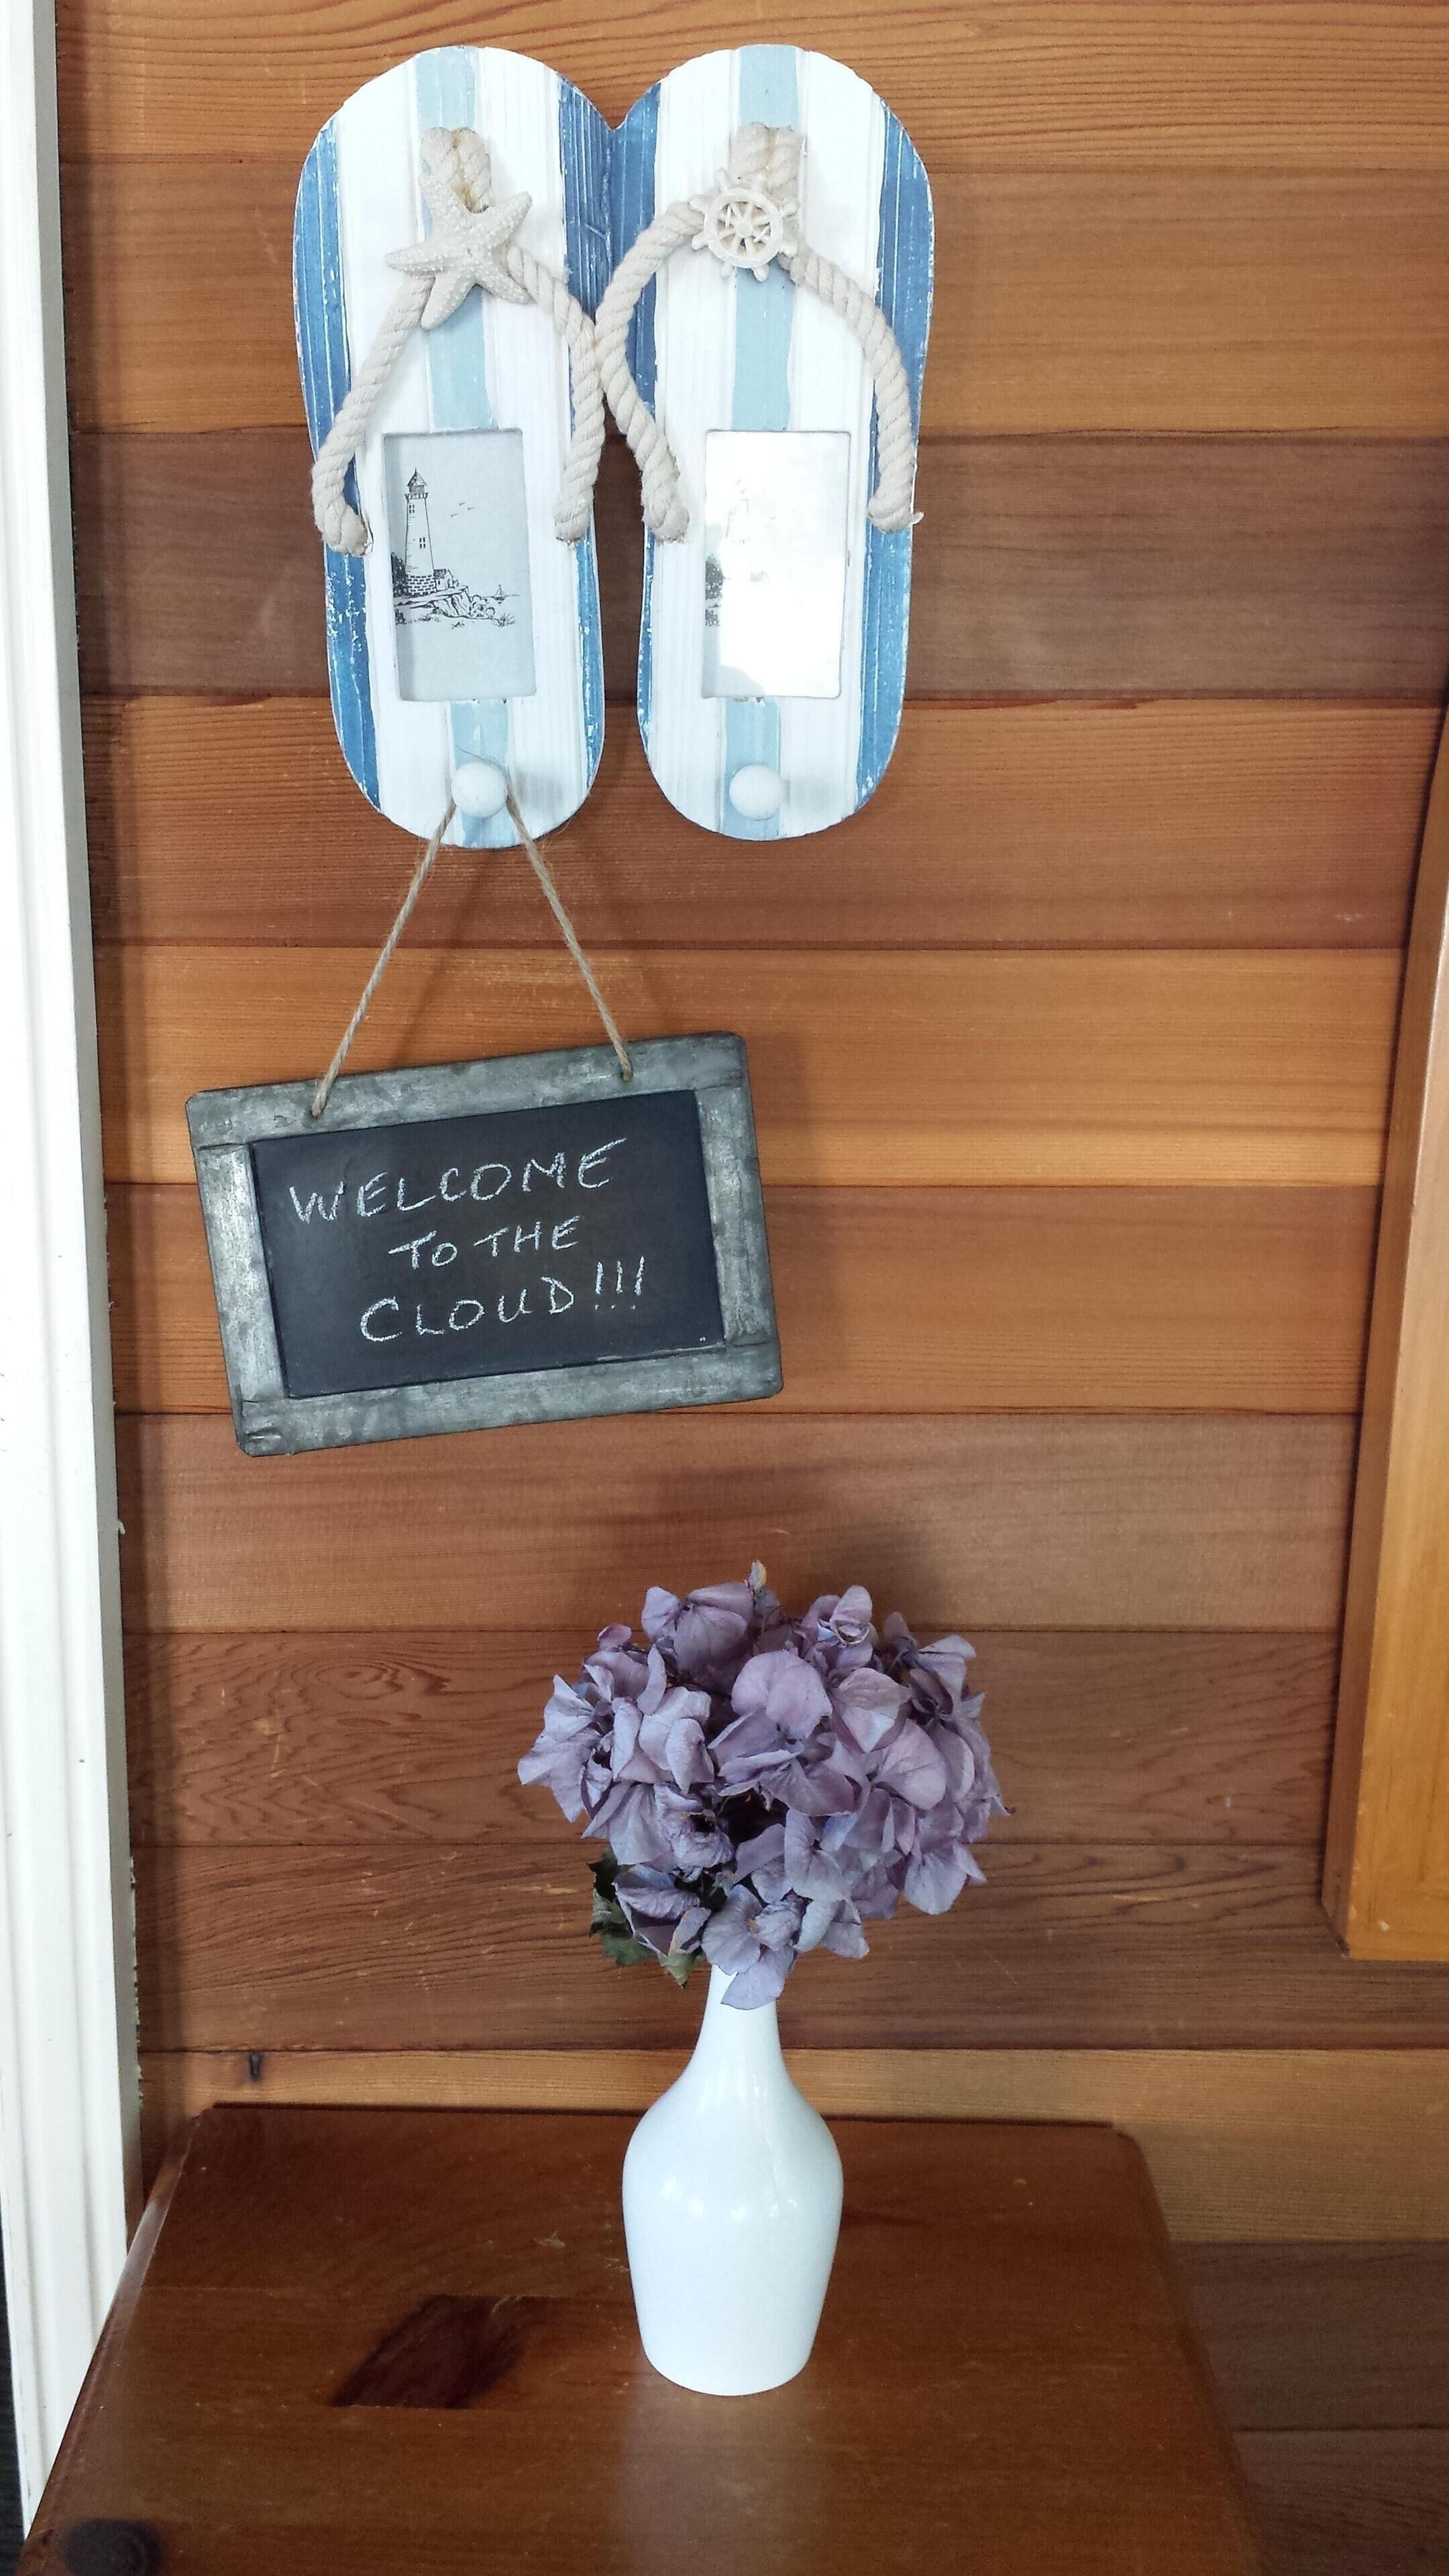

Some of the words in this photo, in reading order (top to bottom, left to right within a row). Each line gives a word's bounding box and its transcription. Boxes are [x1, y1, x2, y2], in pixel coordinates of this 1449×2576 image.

[289, 1138, 627, 1224] WELCOME
[388, 1230, 458, 1269] TO
[473, 1216, 582, 1257] THE
[360, 1256, 645, 1342] CLOUD!!!
